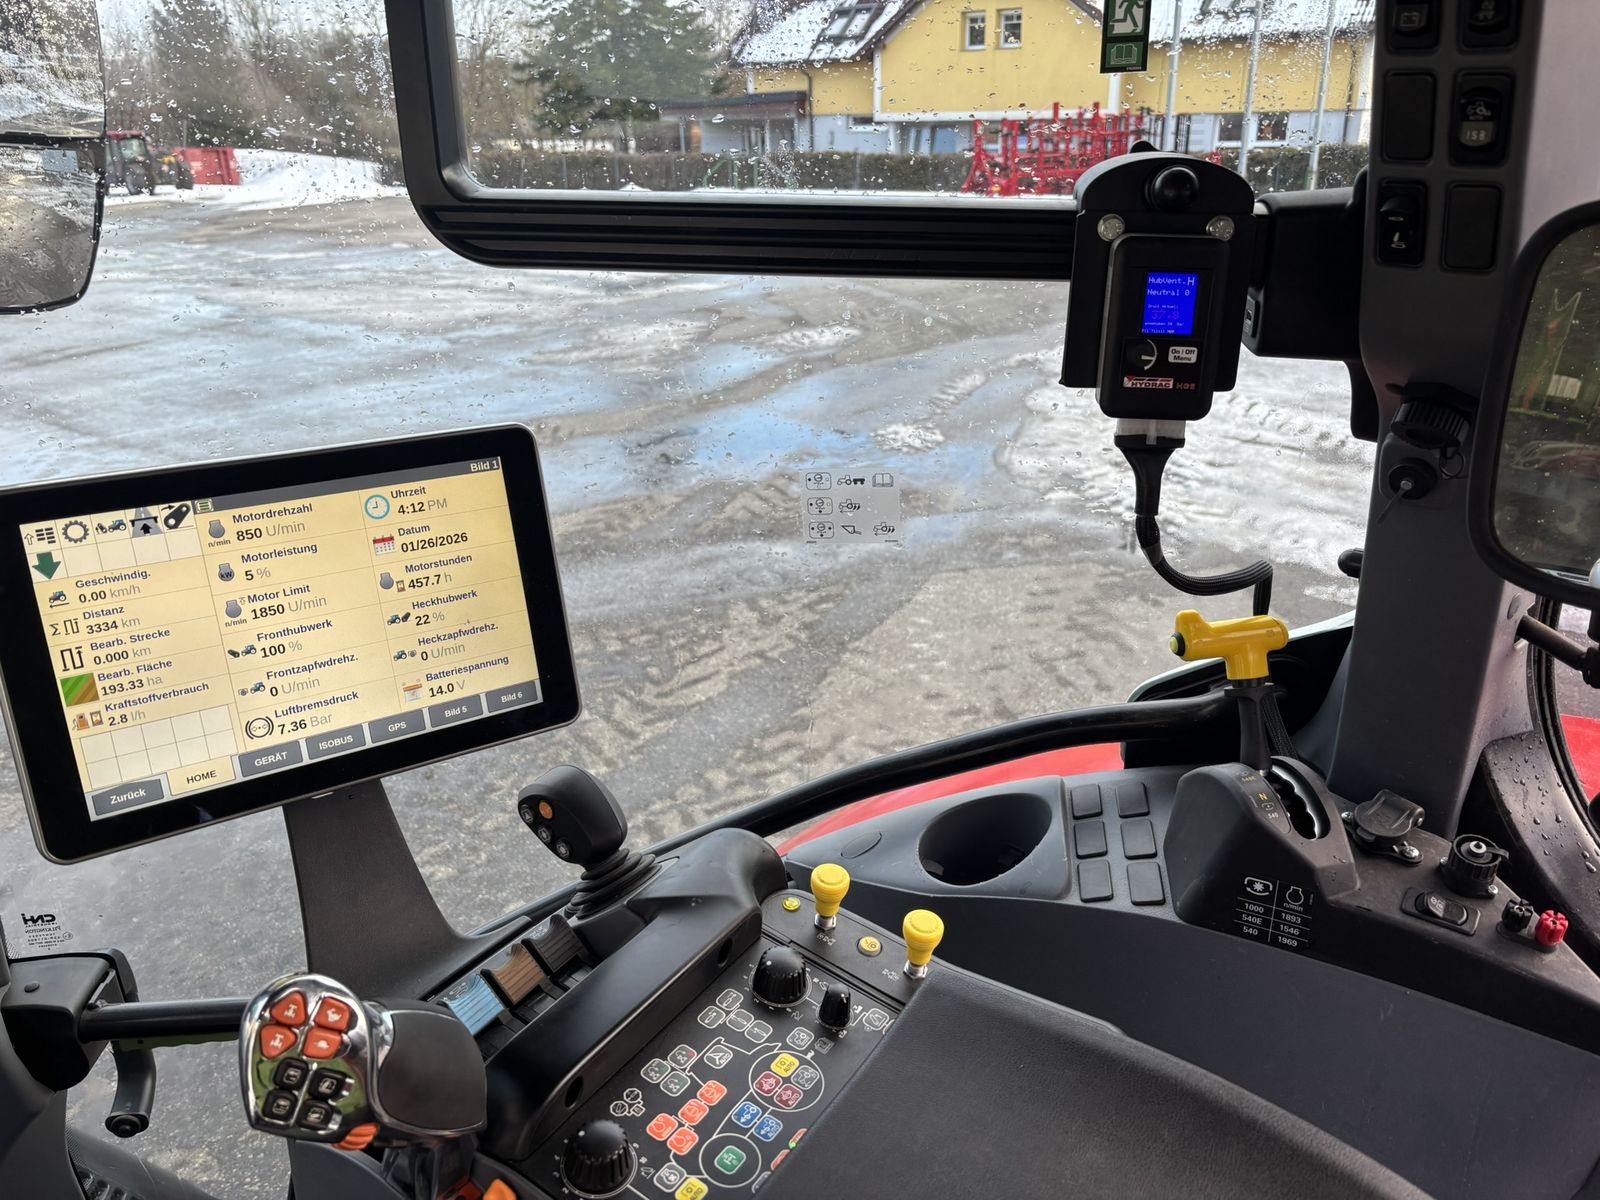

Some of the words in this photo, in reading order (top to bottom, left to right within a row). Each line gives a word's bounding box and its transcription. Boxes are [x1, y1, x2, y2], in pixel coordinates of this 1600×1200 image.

[470, 461, 490, 472] Bild
[492, 460, 498, 470] 1
[391, 486, 426, 499] Uhrzeit
[232, 503, 313, 524] Motordrehzahl
[397, 502, 425, 516] 4:12
[428, 498, 448, 511] PM
[236, 527, 263, 542] 850
[266, 521, 306, 537] U/min
[398, 524, 430, 537] Datum
[208, 538, 231, 548] n/min
[401, 532, 468, 553] 01/26/2026
[241, 543, 318, 563] Motorleistung
[405, 554, 472, 574] Motorstunden
[75, 570, 151, 589] Geschwindig.
[245, 570, 254, 581] 5
[257, 568, 271, 579] %
[408, 574, 441, 590] 457.7
[444, 572, 452, 583] h
[78, 590, 107, 604] 0.00
[110, 584, 141, 598] km/h
[247, 591, 280, 604] Motor
[283, 584, 311, 597] Limit
[412, 589, 478, 610] Heckhubwerk
[83, 606, 125, 620] Distanz
[251, 604, 285, 620] 1850
[288, 596, 327, 612] U/min
[86, 620, 118, 634] 3334
[121, 616, 141, 628] km
[225, 618, 248, 627] n/min
[415, 614, 431, 626] 22
[432, 611, 445, 622] %
[90, 637, 126, 651] Bearb.
[129, 628, 171, 643] Strecke
[257, 619, 333, 642] Fronthubwerk
[418, 623, 499, 646] Heckzapfwdrehz.
[93, 650, 129, 665] 0.000
[132, 646, 152, 658] km
[260, 644, 286, 658] 100
[289, 640, 302, 652] %
[420, 651, 428, 661] 0
[431, 644, 466, 659] U/min
[98, 668, 134, 681] Bearb.
[136, 659, 172, 673] Fläche
[266, 654, 358, 680] Frontzapfwdrehz.
[426, 656, 509, 682] Batteriespannung
[100, 678, 144, 696] 193.33
[146, 675, 164, 686] ha
[270, 686, 279, 697] 0
[281, 677, 321, 694] U/min
[429, 683, 455, 698] 14.0
[456, 680, 466, 690] V
[104, 682, 209, 712] Kraftstoffverbrauch
[274, 691, 359, 718] Luftbremsdruck
[501, 693, 516, 703] Bild
[108, 714, 129, 727] 2.8
[444, 708, 460, 718] Bild
[462, 705, 468, 713] 5
[277, 719, 307, 735] 7.36
[310, 713, 333, 727] Bar
[388, 722, 407, 732] GPS
[319, 735, 354, 750] ISOBUS
[254, 752, 288, 767] GERÄT
[186, 770, 217, 784] HOME
[110, 788, 146, 805] Zurück
[1244, 902, 1264, 913] 1000
[1282, 912, 1301, 924] 1893
[1242, 914, 1263, 925] 540E
[1280, 924, 1300, 935] 1546
[1243, 926, 1258, 935] 540
[1278, 936, 1298, 947] 1969
[783, 1061, 796, 1073] AUTO
[788, 1093, 800, 1105] AUTO
[768, 1125, 779, 1137] AUTO
